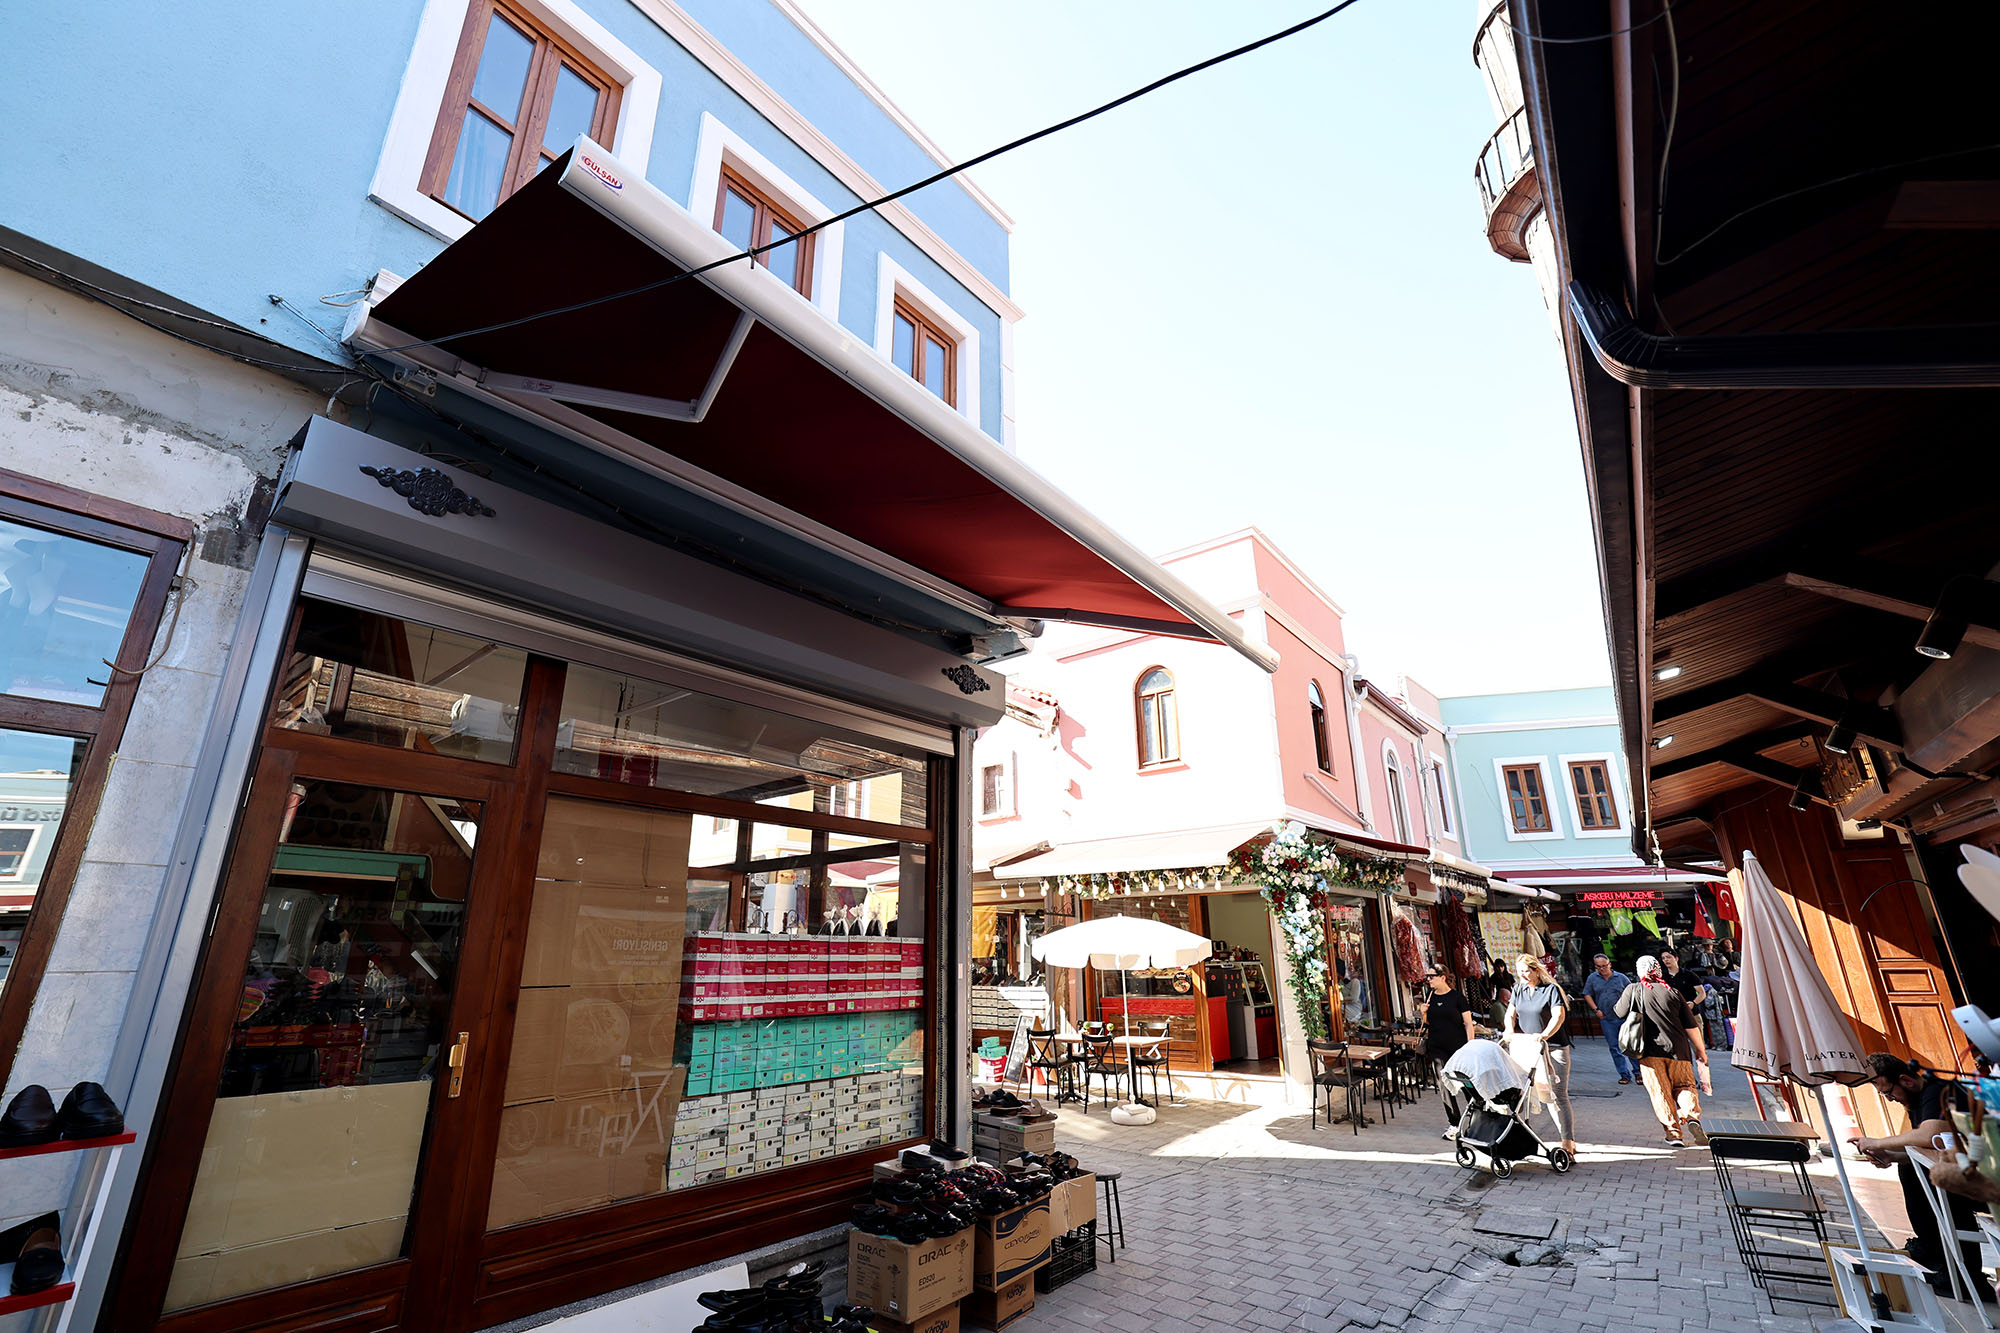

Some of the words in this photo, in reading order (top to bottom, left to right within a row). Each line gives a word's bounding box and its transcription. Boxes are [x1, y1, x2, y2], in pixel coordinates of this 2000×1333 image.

[583, 157, 618, 186] GÜLSAN
[1614, 890, 1655, 900] MALZEME
[857, 1242, 887, 1258] ORAC
[918, 1243, 952, 1266] ORAC
